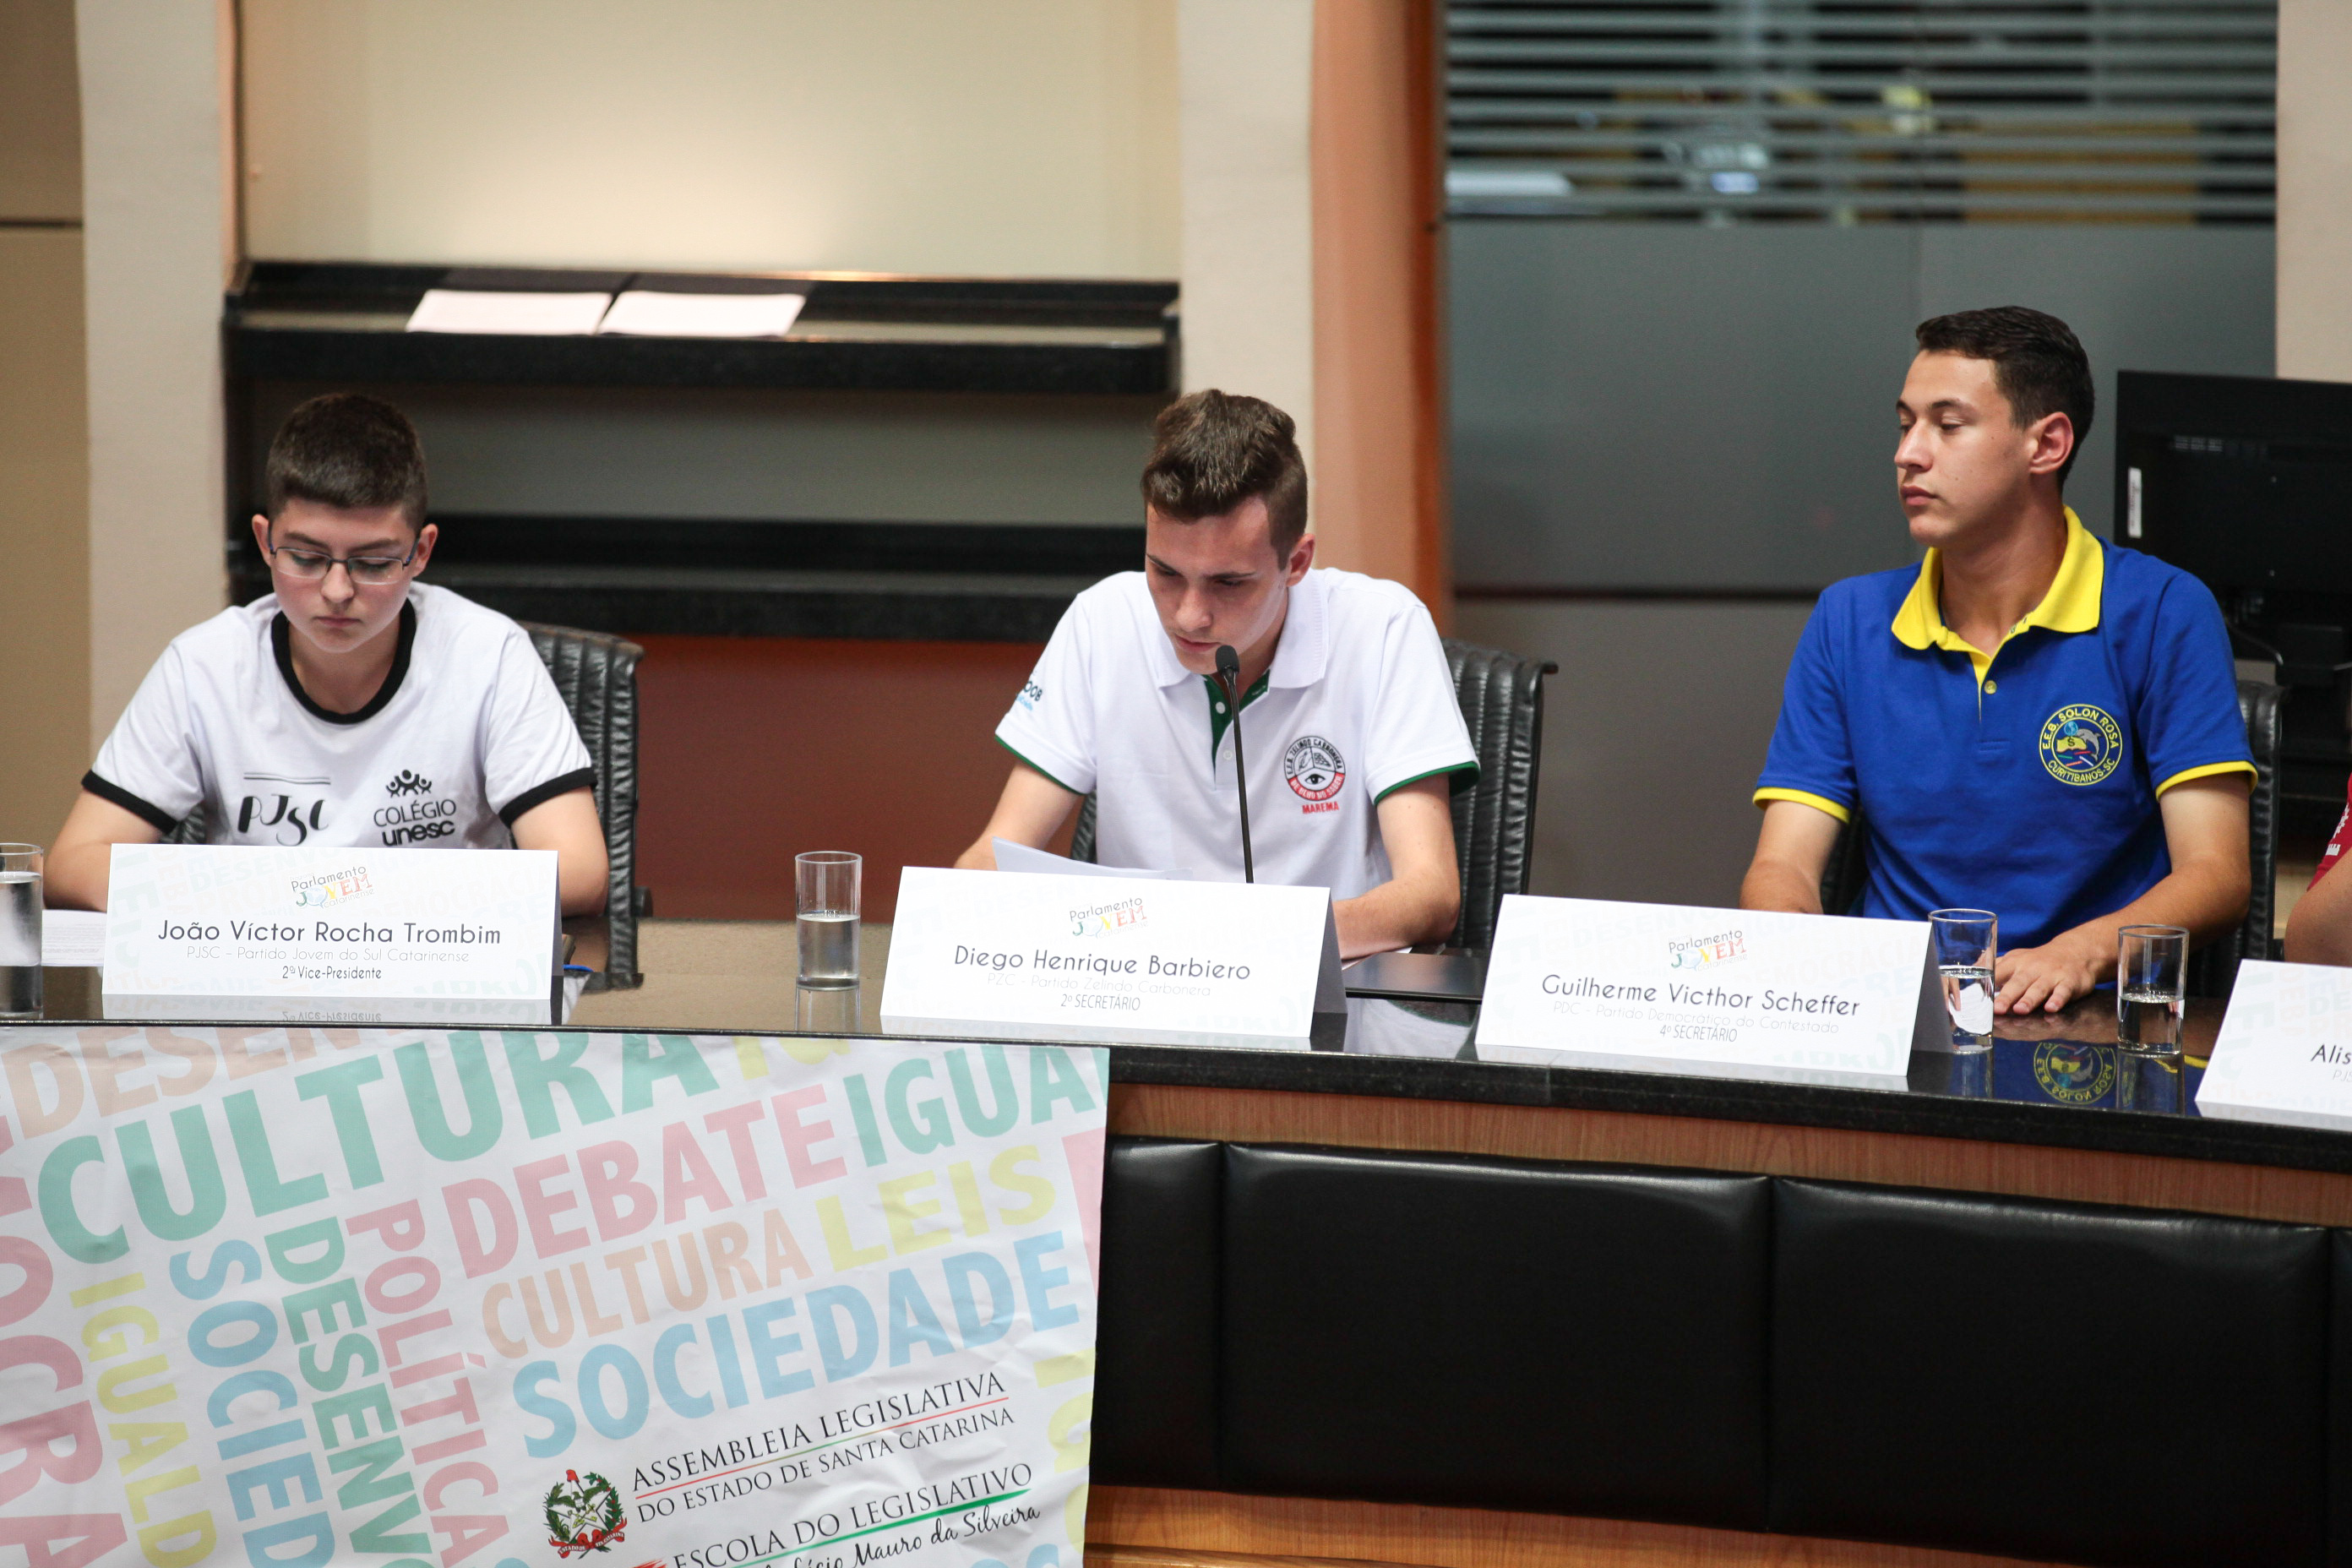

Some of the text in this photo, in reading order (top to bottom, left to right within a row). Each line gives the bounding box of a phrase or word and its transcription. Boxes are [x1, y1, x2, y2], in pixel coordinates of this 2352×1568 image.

[2058, 707, 2099, 722] SOLON
[2099, 716, 2120, 749] ROSA
[373, 799, 456, 827] COLÉGIO
[1302, 801, 1339, 814] MAREMA
[382, 820, 455, 847] unesc
[291, 866, 367, 892] Parlamento
[324, 888, 375, 908] catarinense
[1069, 896, 1143, 922] Parlamento
[157, 919, 502, 945] João Víctor Rocha Trombim
[1668, 929, 1743, 954] Parlamento
[187, 946, 220, 960] PJSC
[237, 946, 286, 961] Partido
[291, 947, 334, 961] Jovem
[339, 947, 358, 961] do
[362, 948, 383, 961] Sul
[387, 948, 470, 963] Catarinense
[954, 945, 1251, 981] Diego Henrique Barbiero
[1697, 951, 1748, 972] catarinense
[297, 966, 382, 980] Vice-Presidente
[988, 972, 1015, 986] PZC
[1032, 975, 1079, 990] Partido
[1084, 977, 1133, 992] Zelindo
[1138, 980, 1211, 996] Carbonera
[1074, 994, 1141, 1011] SECRETÁRIO
[1541, 973, 1861, 1016] Guilherme Victhor Scheffer
[1553, 1000, 1581, 1015] PDC
[1596, 1003, 1644, 1021] Partido
[1735, 1013, 1756, 1028] do
[1759, 1015, 1840, 1035] Contestado
[1673, 1024, 1738, 1043] SECRETÁRIO
[38, 1031, 720, 1265] CULTURA
[441, 1084, 847, 1279] DEBATE
[814, 1144, 1057, 1273] LEIS
[482, 1208, 814, 1359] CULTURA
[512, 1231, 1081, 1459] SOCIEDADE
[264, 1215, 439, 1568] DESENV
[345, 1199, 510, 1568] POLÍTICA
[69, 1271, 217, 1568] IGUALD
[169, 1239, 336, 1568] SOCIED
[632, 1371, 1005, 1491] ASSEMBLEIA LEGISLATIVA
[637, 1407, 1015, 1523] DO ESTADO DE SANTA CATARINA
[673, 1462, 1032, 1568] ESCOLA DO LEGISLATIVO
[853, 1536, 922, 1568] Mauro
[930, 1518, 958, 1545] da
[963, 1505, 1041, 1538] Silveira
